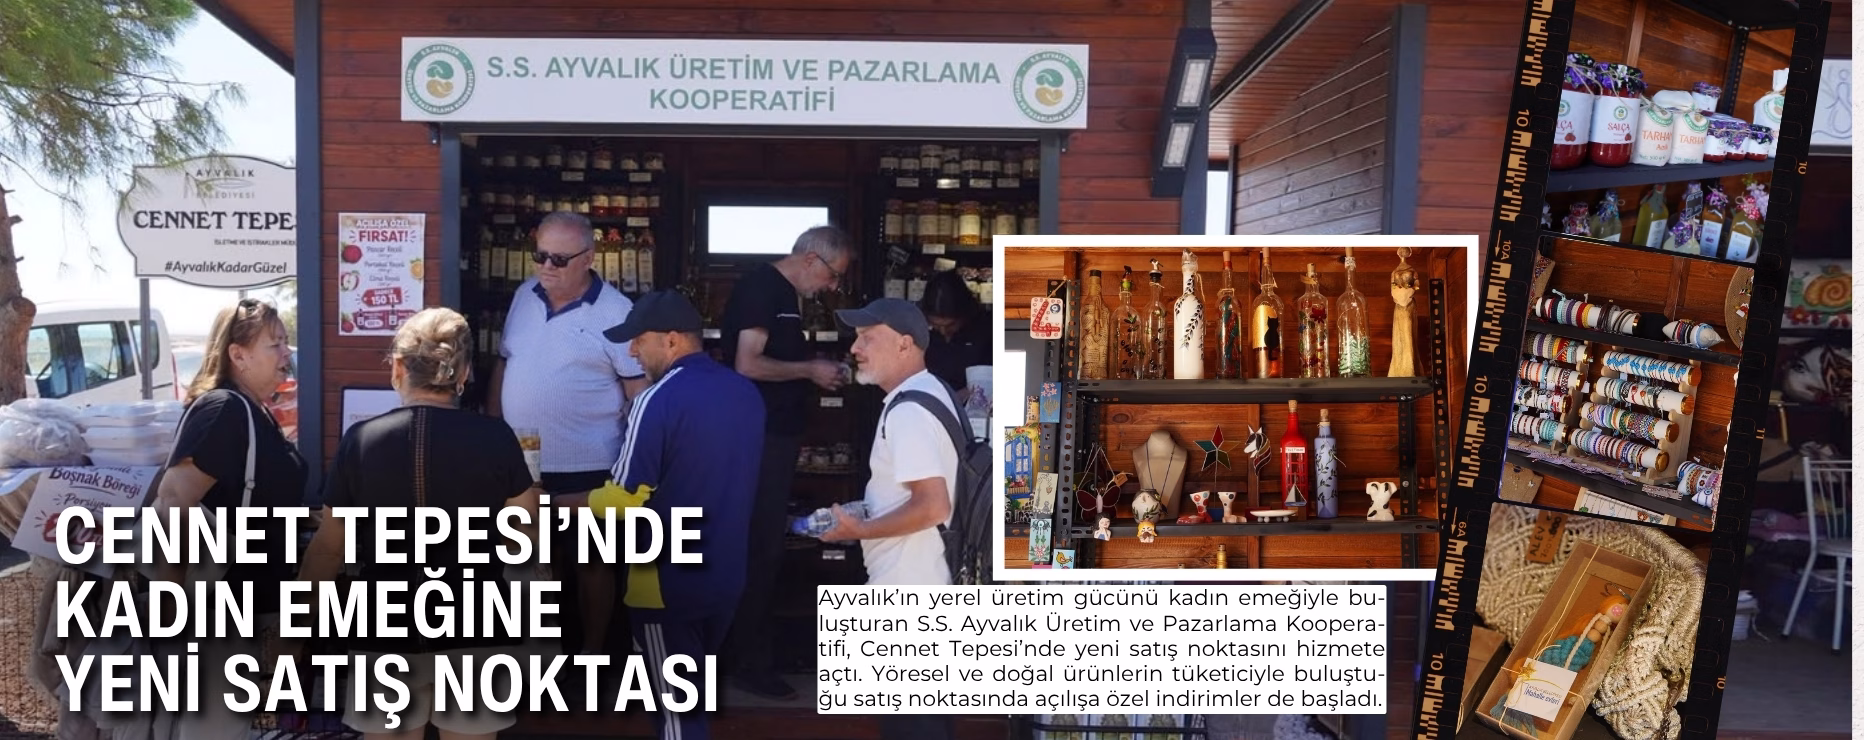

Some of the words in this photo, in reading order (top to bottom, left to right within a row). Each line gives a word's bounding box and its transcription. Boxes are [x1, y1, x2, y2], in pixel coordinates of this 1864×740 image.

[487, 56, 537, 78] S.S.
[544, 56, 660, 79] AYVALIK
[669, 53, 773, 80] ÜRETİM
[782, 59, 819, 81] VE
[828, 60, 1001, 84] PAZARLAMA
[650, 86, 835, 112] KOOPERATİFİ
[1557, 120, 1573, 131] LÇA
[1607, 122, 1631, 132] SALÇA
[196, 169, 254, 178] AYVALIK
[133, 210, 227, 230] CENNET
[232, 211, 296, 231] TEPE
[358, 230, 409, 242] FIRSAT!
[164, 260, 288, 274] #AyvalıkKadarGüzel
[371, 295, 387, 305] 150
[388, 293, 400, 303] TL
[49, 466, 102, 486] Boşnak
[102, 474, 143, 499] Böreği
[1530, 526, 1545, 556] ALEV
